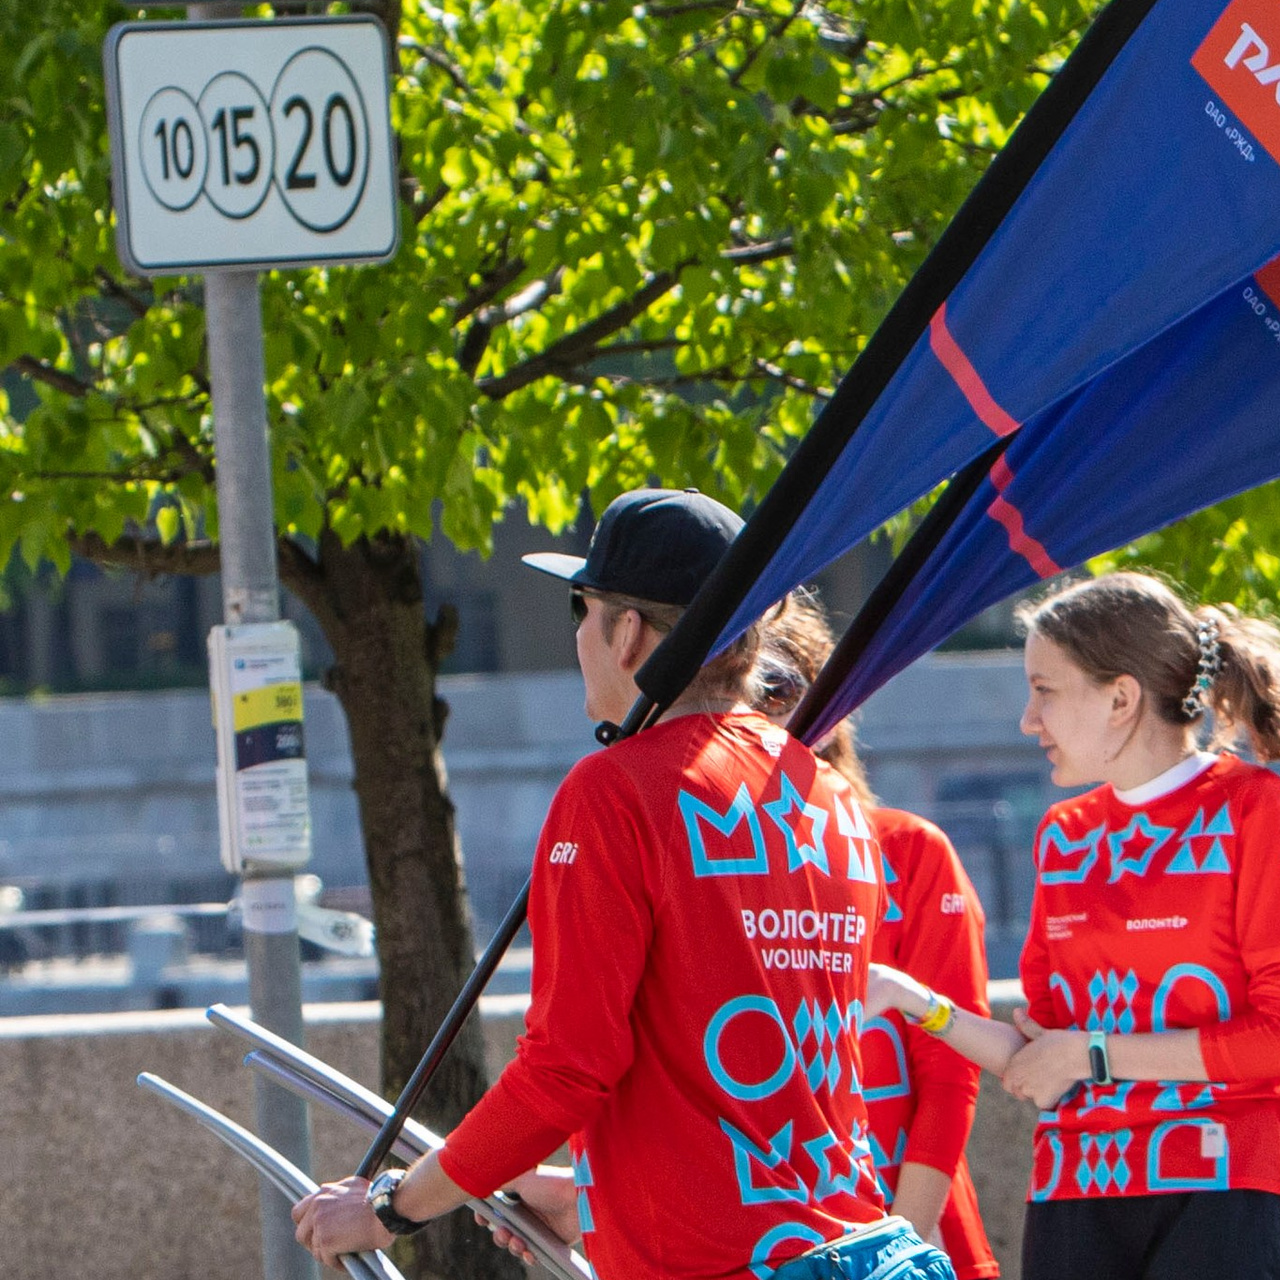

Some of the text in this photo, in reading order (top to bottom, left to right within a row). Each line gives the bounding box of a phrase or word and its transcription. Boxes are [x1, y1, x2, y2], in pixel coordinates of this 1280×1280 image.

[1204, 100, 1227, 127] ОАО
[155, 93, 357, 190] 10 15 20
[1242, 287, 1266, 316] ОАО
[741, 906, 866, 944] ВОЛОНТЁР
[761, 948, 853, 973] VOLUNEER
